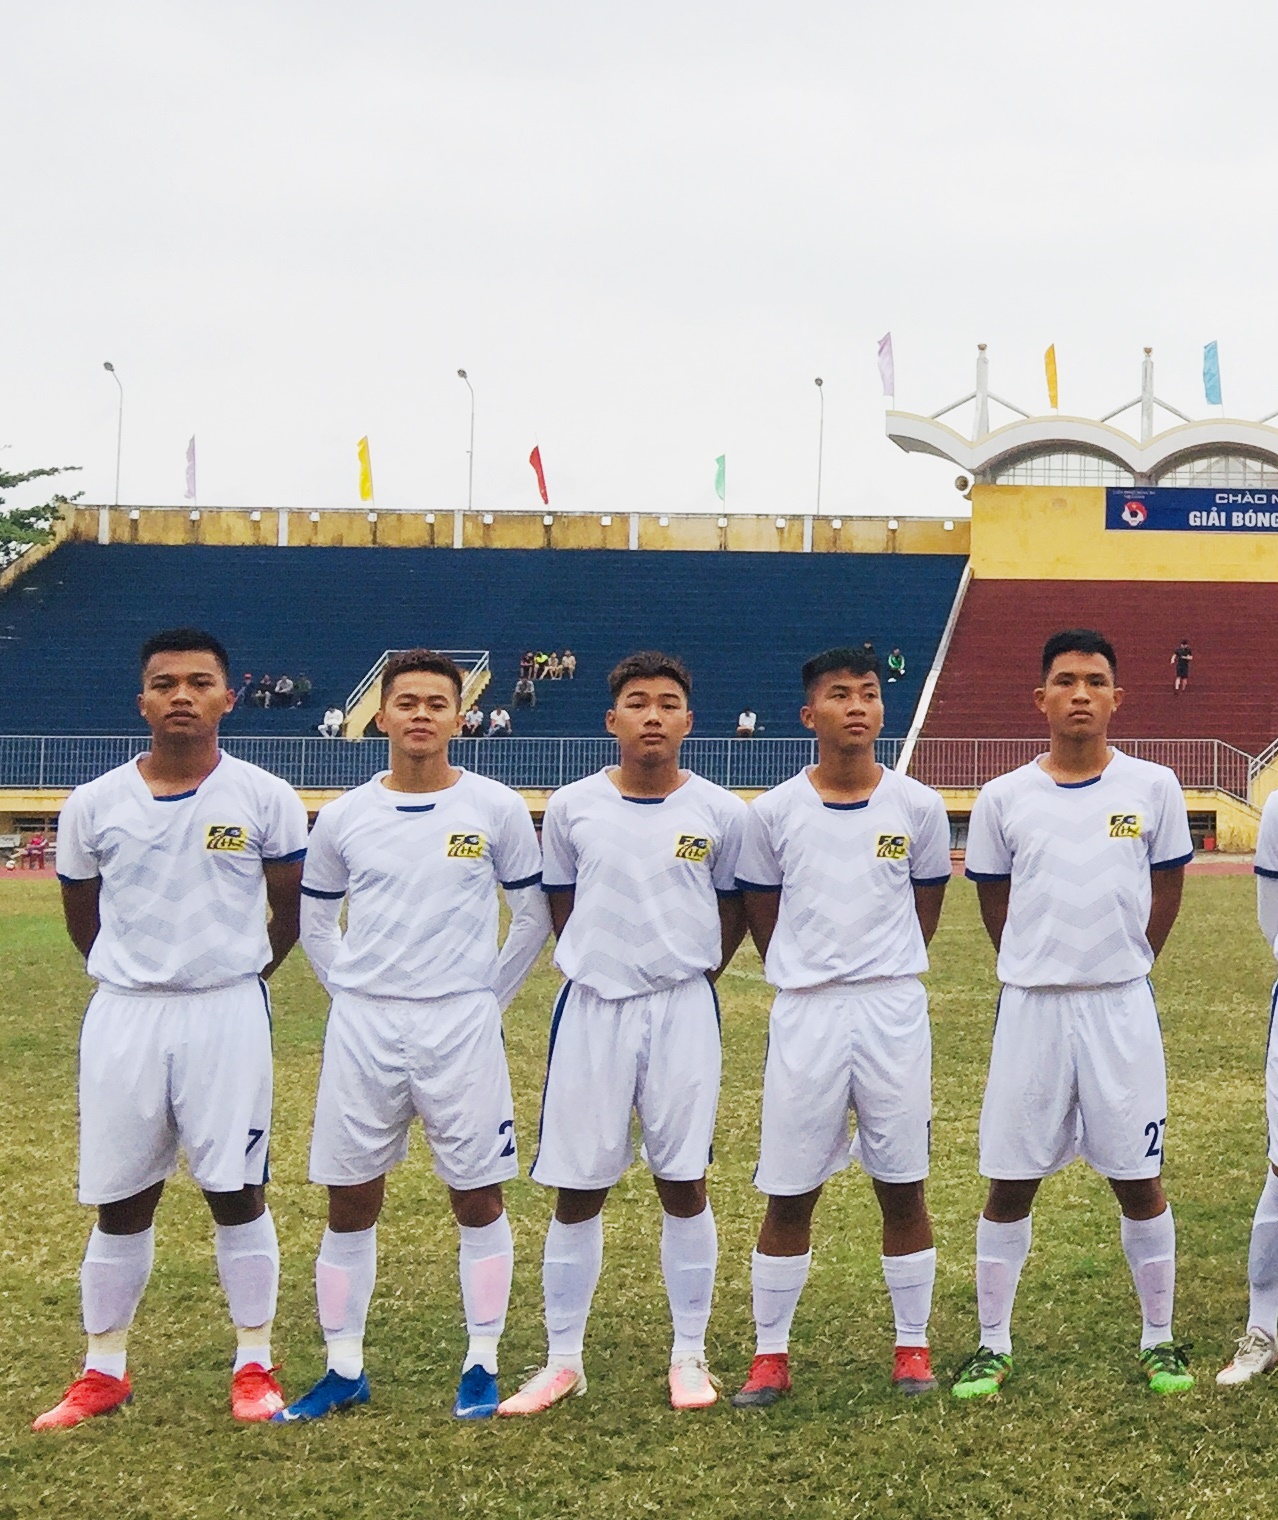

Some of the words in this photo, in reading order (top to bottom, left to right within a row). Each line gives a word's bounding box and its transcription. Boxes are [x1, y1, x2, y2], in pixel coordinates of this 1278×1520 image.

[1215, 491, 1267, 504] CHÀO
[1188, 507, 1227, 527] GIẢI
[1110, 814, 1137, 825] FC
[209, 826, 242, 838] FC
[450, 834, 480, 845] FC
[680, 835, 708, 849] FC
[879, 835, 905, 846] FC
[245, 1129, 264, 1156] 7
[498, 1119, 516, 1157] 2
